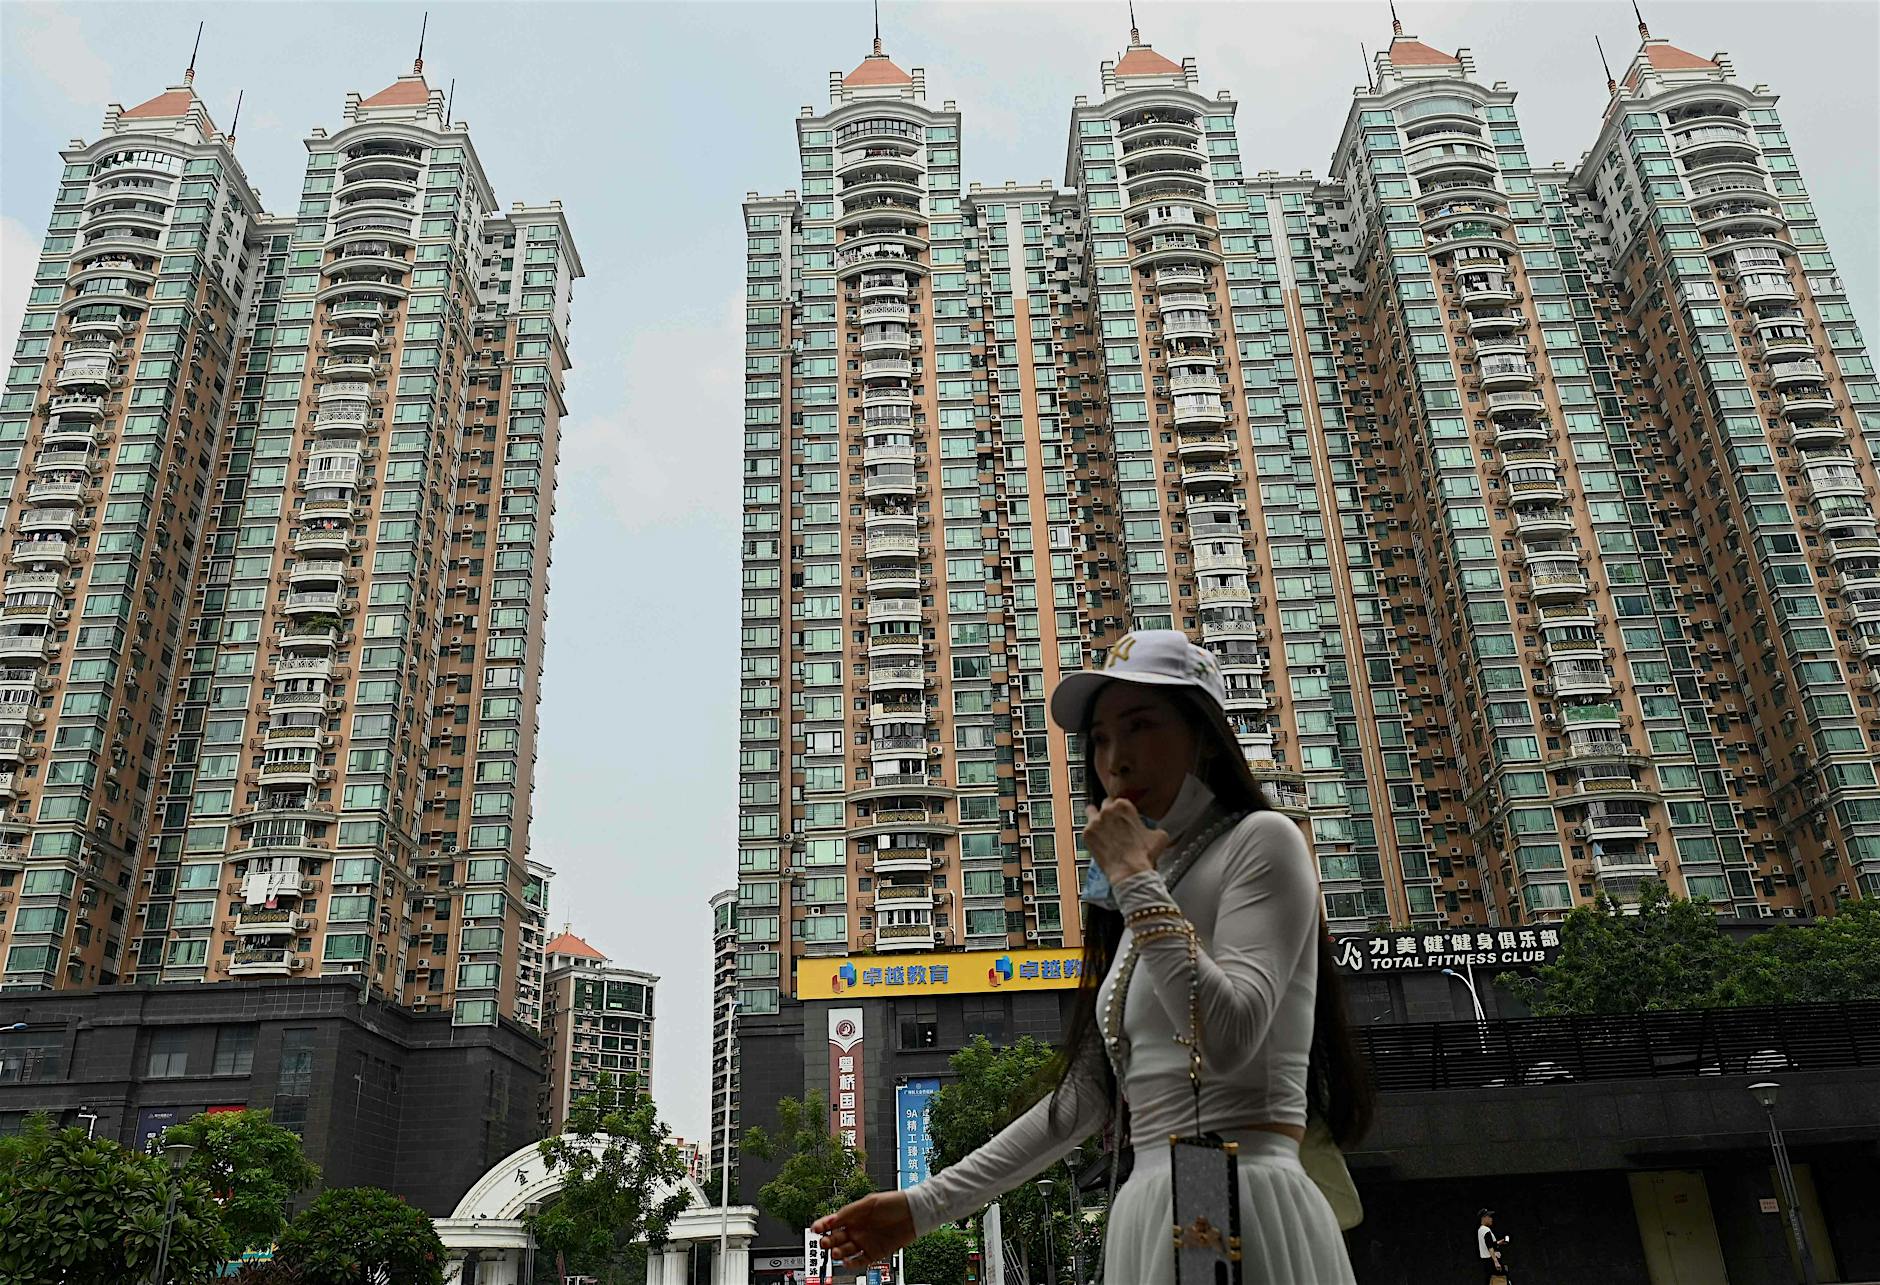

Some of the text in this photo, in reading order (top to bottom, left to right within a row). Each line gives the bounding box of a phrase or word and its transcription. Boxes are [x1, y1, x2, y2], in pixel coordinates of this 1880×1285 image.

[1370, 950, 1545, 970] TOTAL FITNESS CLUB
[863, 965, 948, 986] 卓越教育
[906, 1109, 919, 1190] 9A精工臻筑美
[514, 1168, 529, 1185] 金
